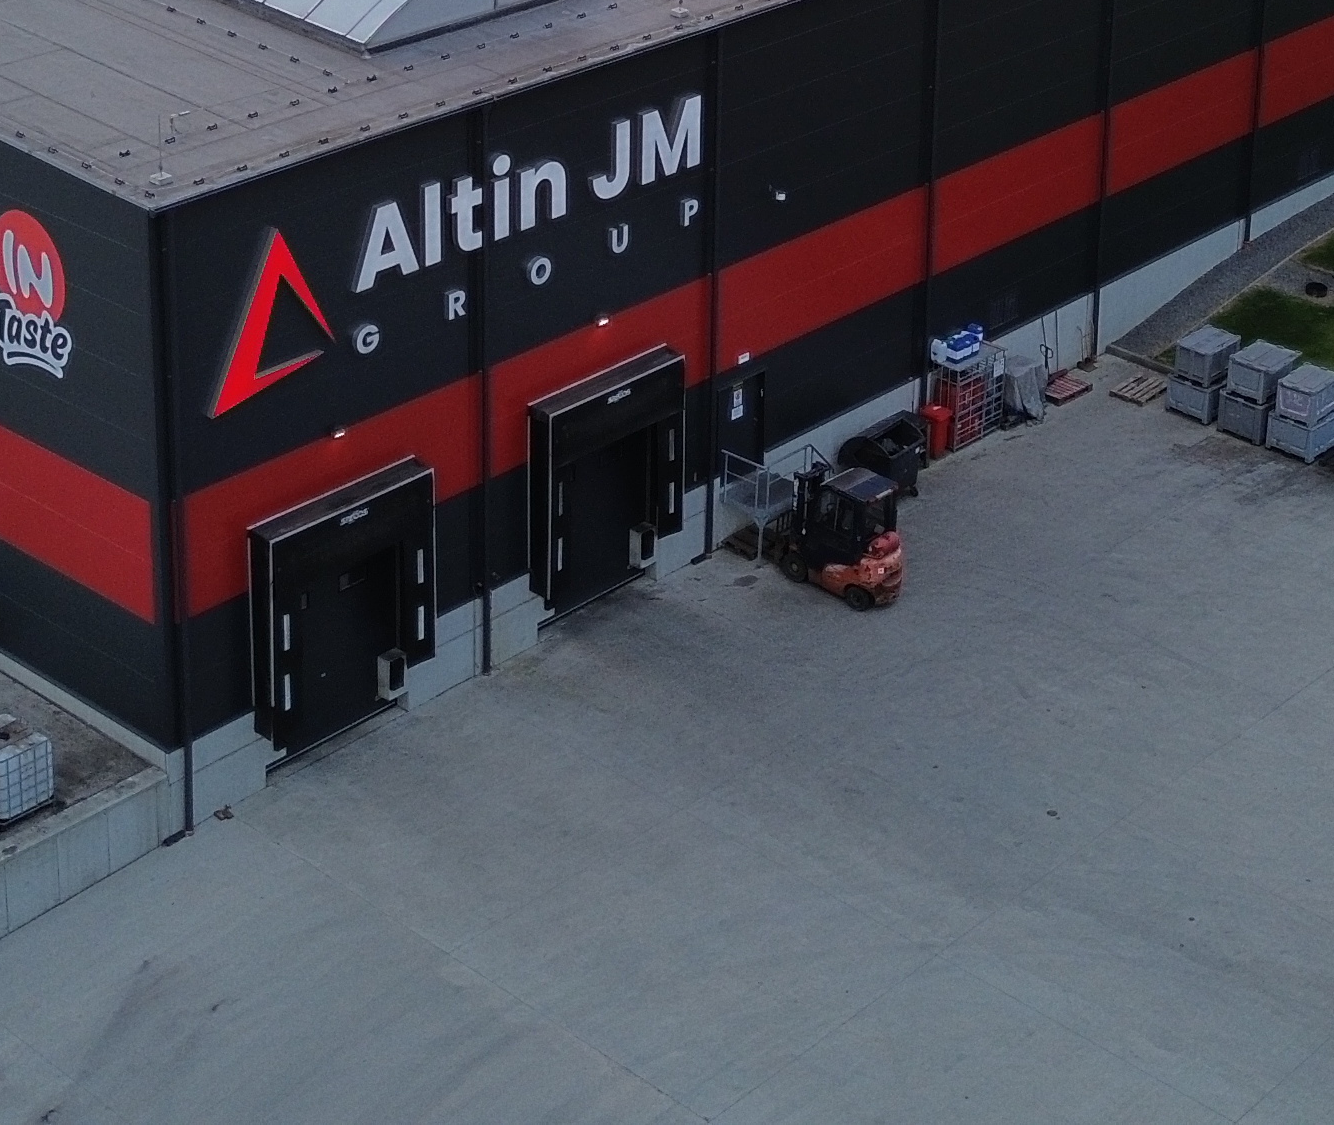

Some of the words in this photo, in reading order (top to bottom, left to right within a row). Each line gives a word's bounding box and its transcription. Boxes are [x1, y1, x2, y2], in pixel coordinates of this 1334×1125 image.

[2, 229, 54, 309] IN
[351, 153, 567, 293] Altin
[588, 94, 702, 200] JM
[353, 197, 699, 354] GROUP
